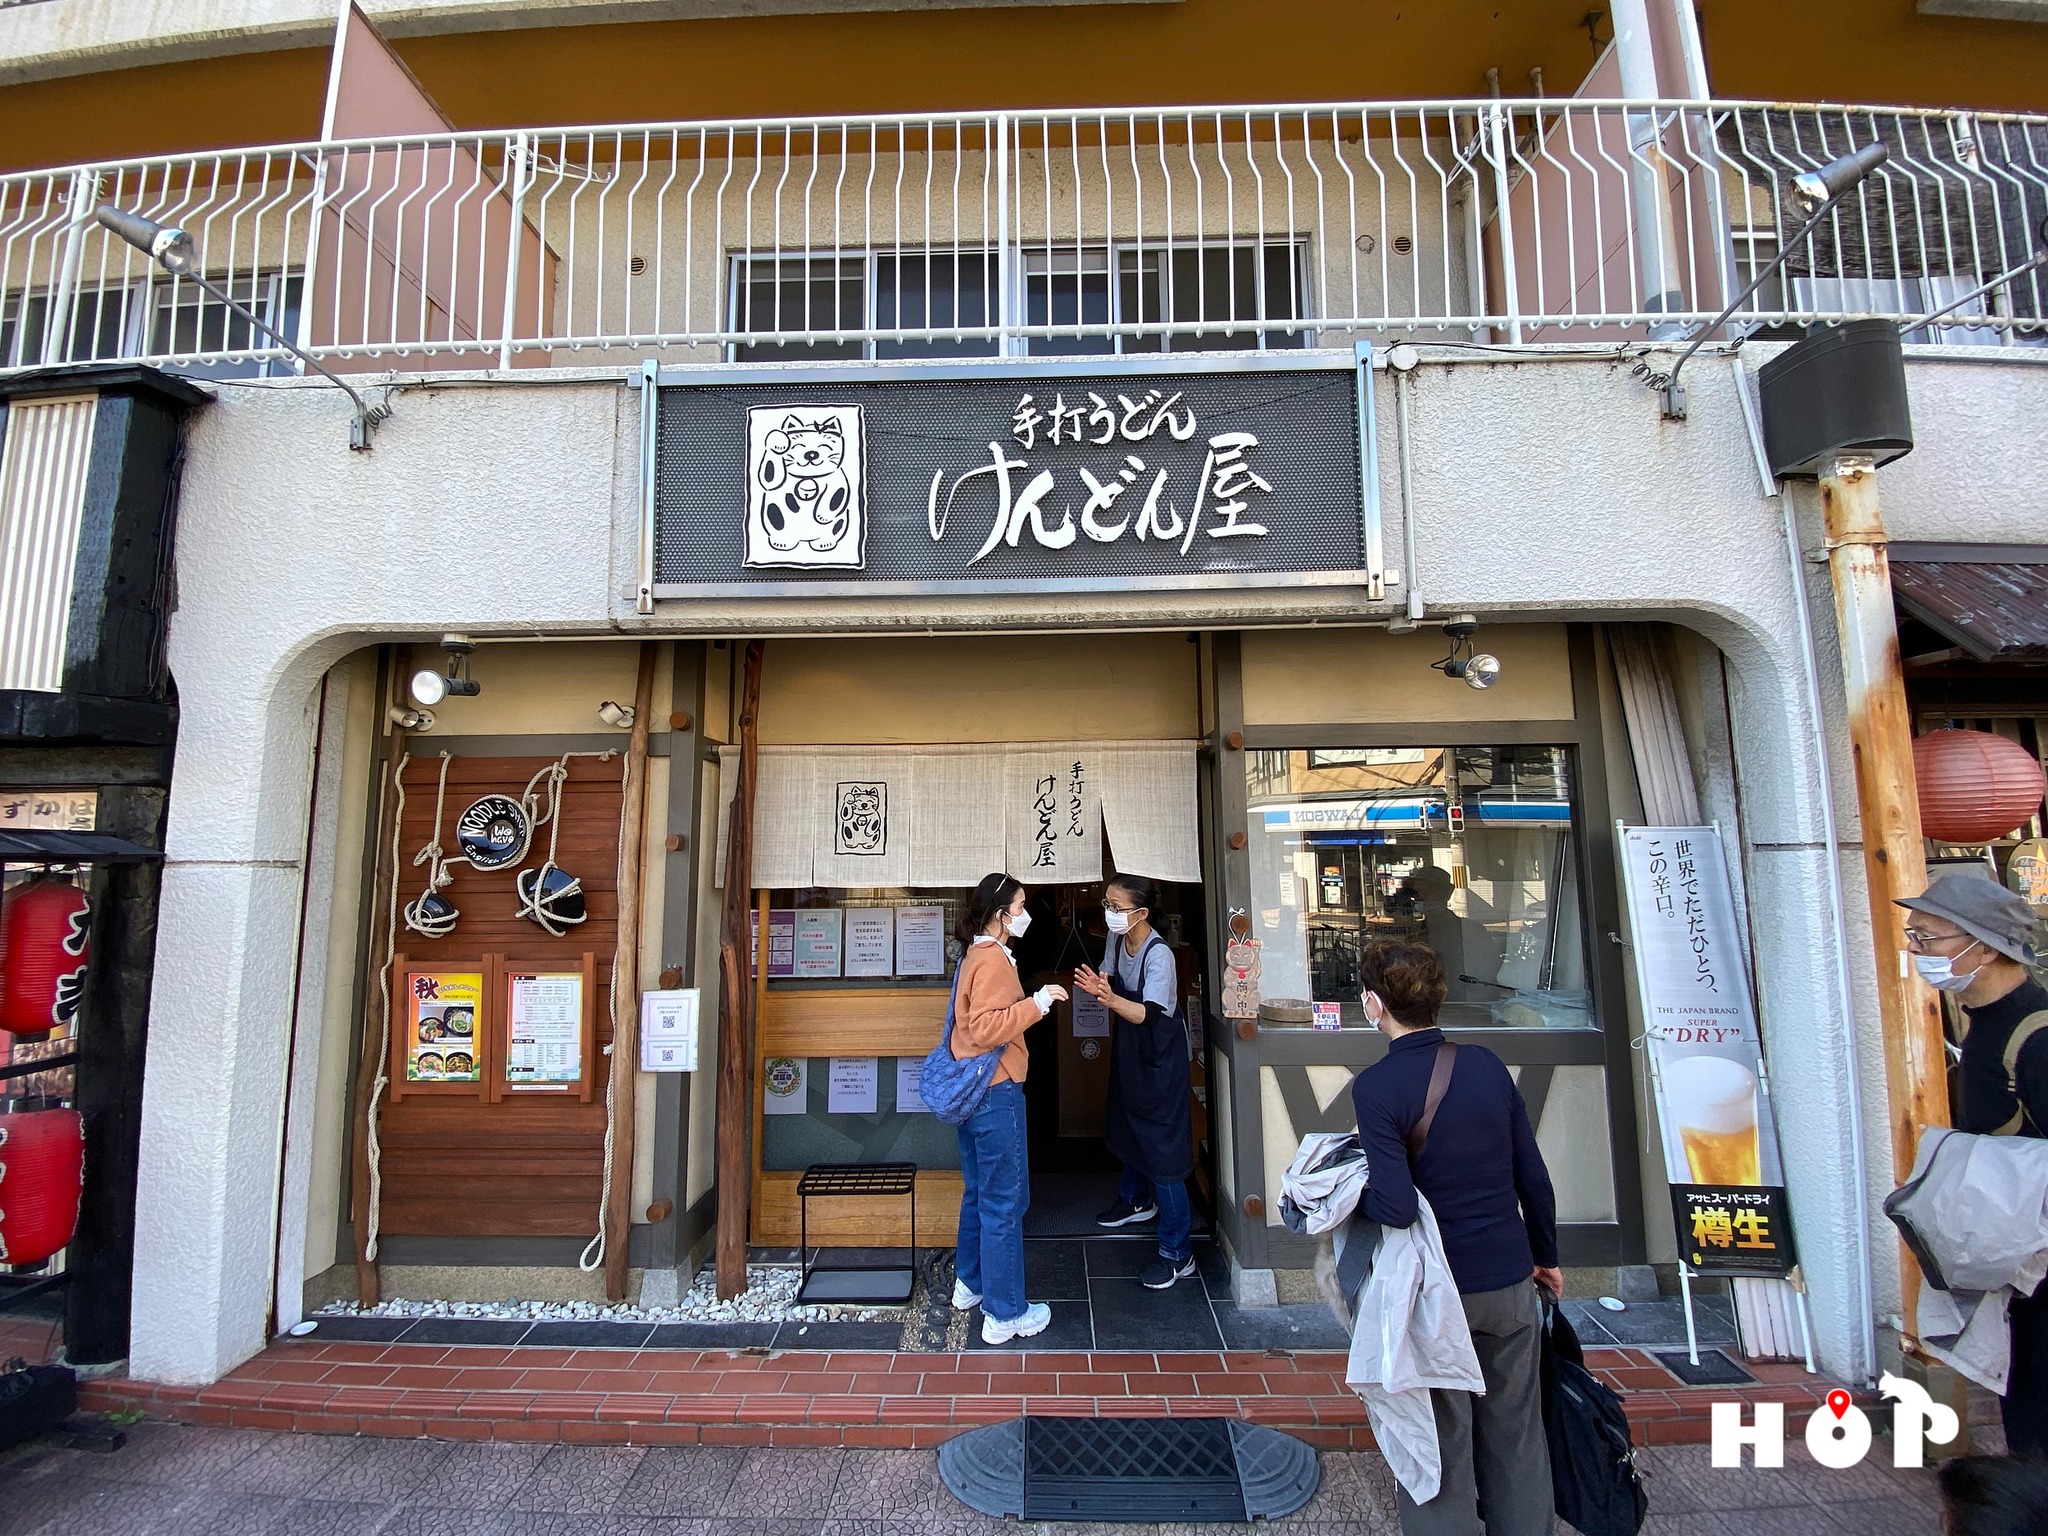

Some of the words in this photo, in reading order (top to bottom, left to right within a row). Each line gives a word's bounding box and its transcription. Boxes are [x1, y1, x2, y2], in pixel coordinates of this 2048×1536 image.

[1013, 389, 1196, 450] 手打うどん
[928, 432, 1273, 567] けんどん屋
[1031, 774, 1058, 867] けんどん屋
[1066, 760, 1085, 837] 手打うどん
[1648, 840, 1675, 919] この辛口。
[1674, 839, 1718, 993] 世界でただひとつ、
[1657, 1006, 1674, 1014] THE
[1678, 1006, 1705, 1014] JAPAN
[1709, 1007, 1738, 1015] BRAND
[1686, 1193, 1770, 1205] アサヒスーパードライ
[1690, 1206, 1776, 1249] 樽生
